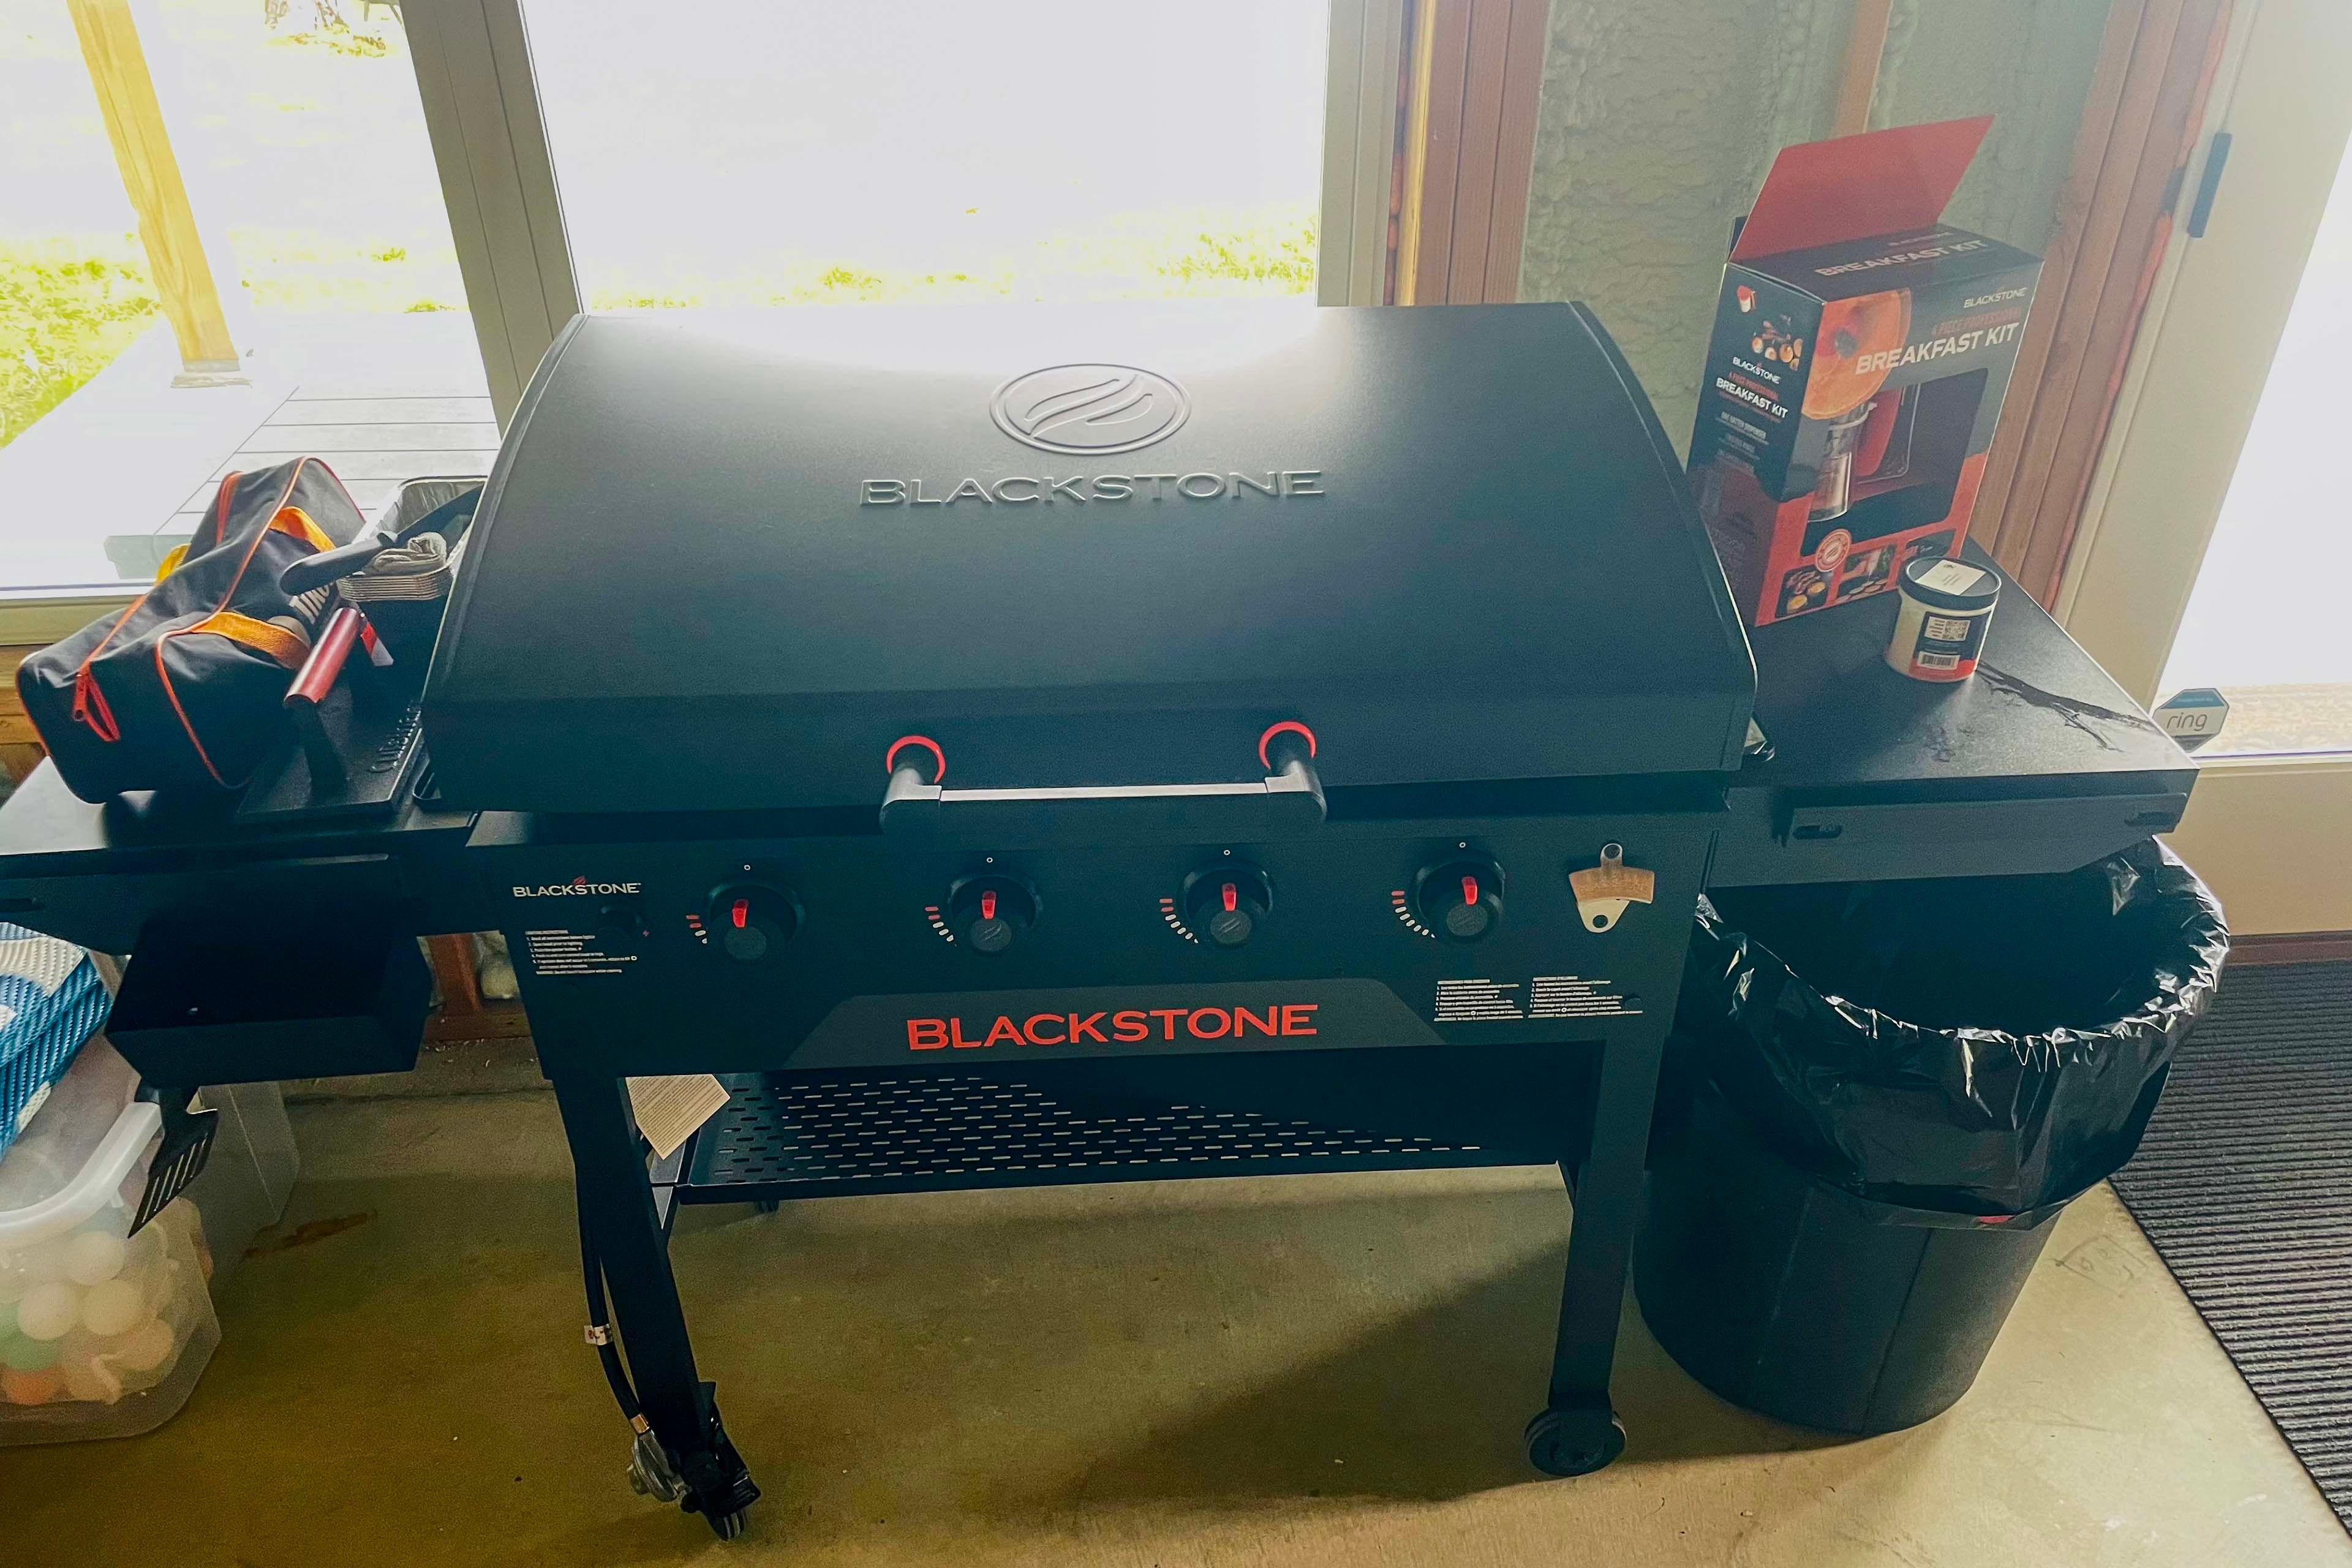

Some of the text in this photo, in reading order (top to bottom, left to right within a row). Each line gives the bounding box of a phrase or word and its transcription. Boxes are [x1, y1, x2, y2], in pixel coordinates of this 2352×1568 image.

[1814, 239, 1987, 276] BREAKFAST KIT
[1964, 287, 2029, 309] BLACKSTONE
[1855, 322, 2019, 375] BREAKFAST KIT
[1732, 356, 1781, 385] BLACKSTONE
[1716, 377, 1772, 410] BREAKFAST
[1771, 404, 1789, 418] KIT
[860, 470, 1327, 507] BLACKSTONE
[2166, 712, 2207, 731] ring
[513, 883, 641, 897] BLACKSTONE
[907, 1004, 1319, 1050] BLACKSTONE
